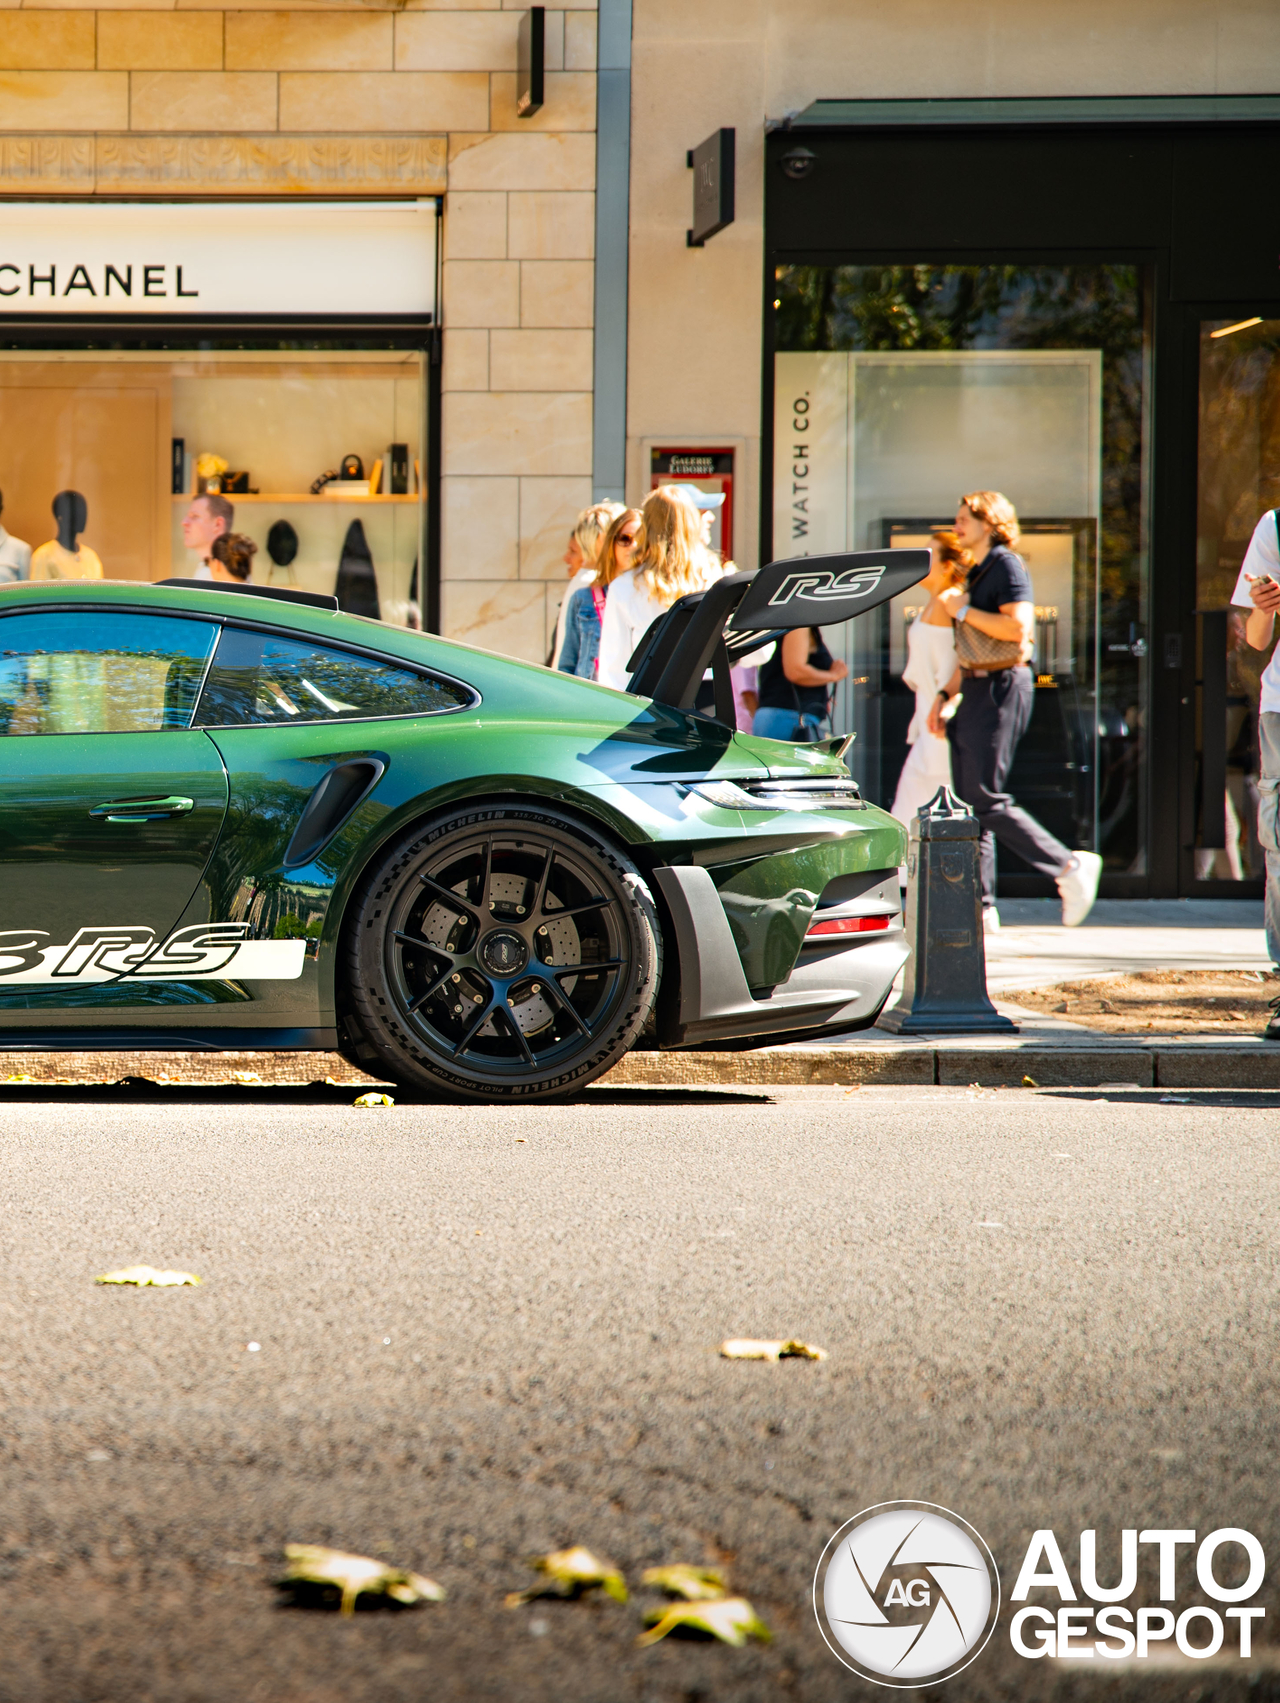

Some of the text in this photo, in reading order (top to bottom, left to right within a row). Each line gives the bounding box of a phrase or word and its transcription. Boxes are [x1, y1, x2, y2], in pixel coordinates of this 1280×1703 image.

[792, 390, 810, 432] CO.
[792, 445, 810, 539] WATCH
[767, 565, 887, 606] RS
[428, 810, 506, 842] MICHELIN
[545, 817, 558, 826] ZR
[479, 1084, 504, 1093] PILOT
[511, 1064, 590, 1095] MICHELIN
